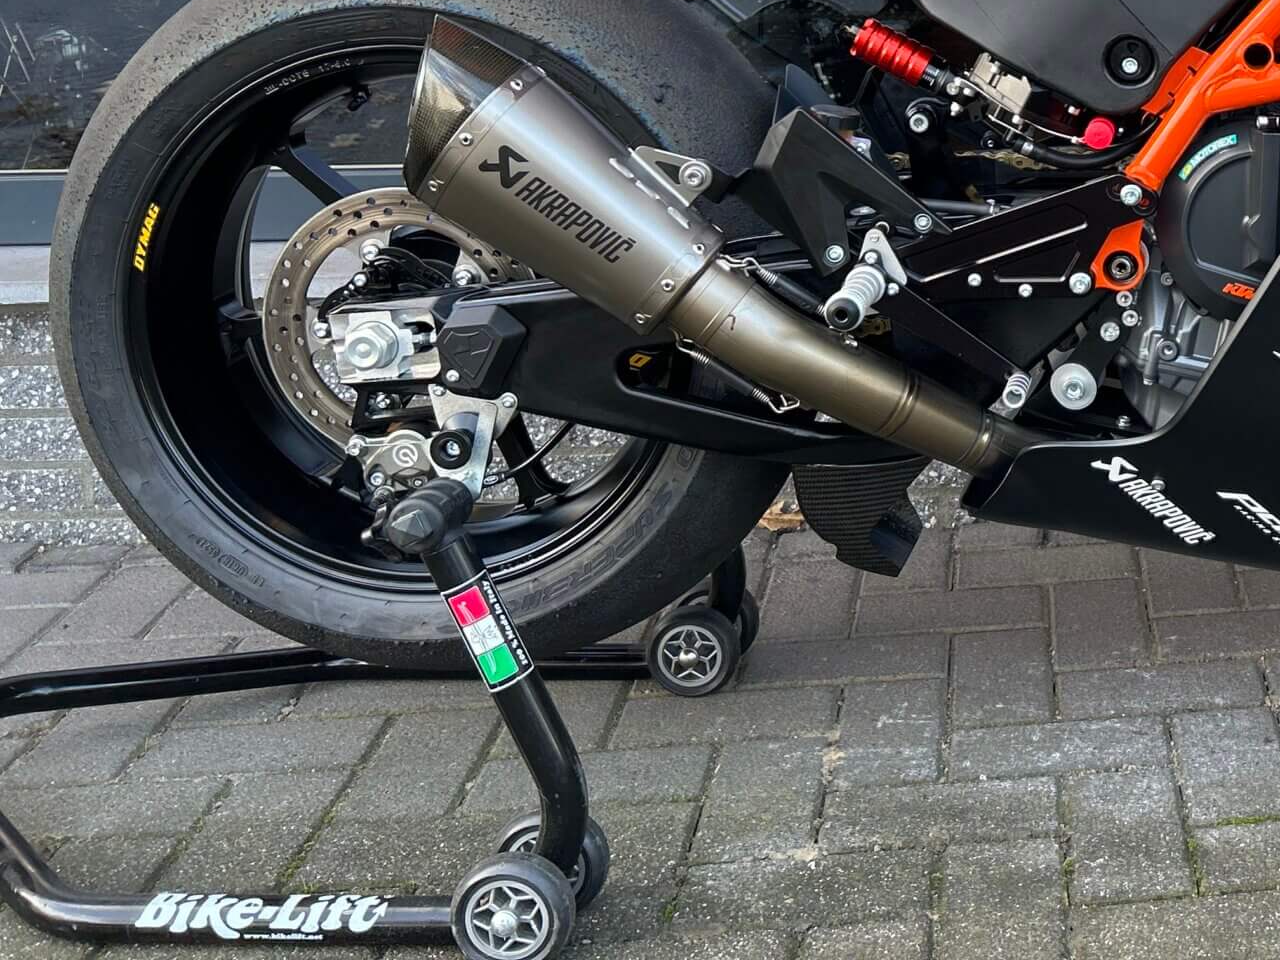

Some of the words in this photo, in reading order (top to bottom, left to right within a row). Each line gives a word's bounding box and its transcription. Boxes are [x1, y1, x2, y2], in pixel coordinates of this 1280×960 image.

[1189, 135, 1236, 167] MOTOREX
[133, 202, 160, 272] DYMAG
[514, 177, 638, 264] AKRAPOVIČ
[1118, 478, 1217, 545] AKRAPOVIČ
[481, 580, 498, 604] Italy
[499, 615, 516, 640] Made
[134, 891, 390, 940] Bike-Lift
